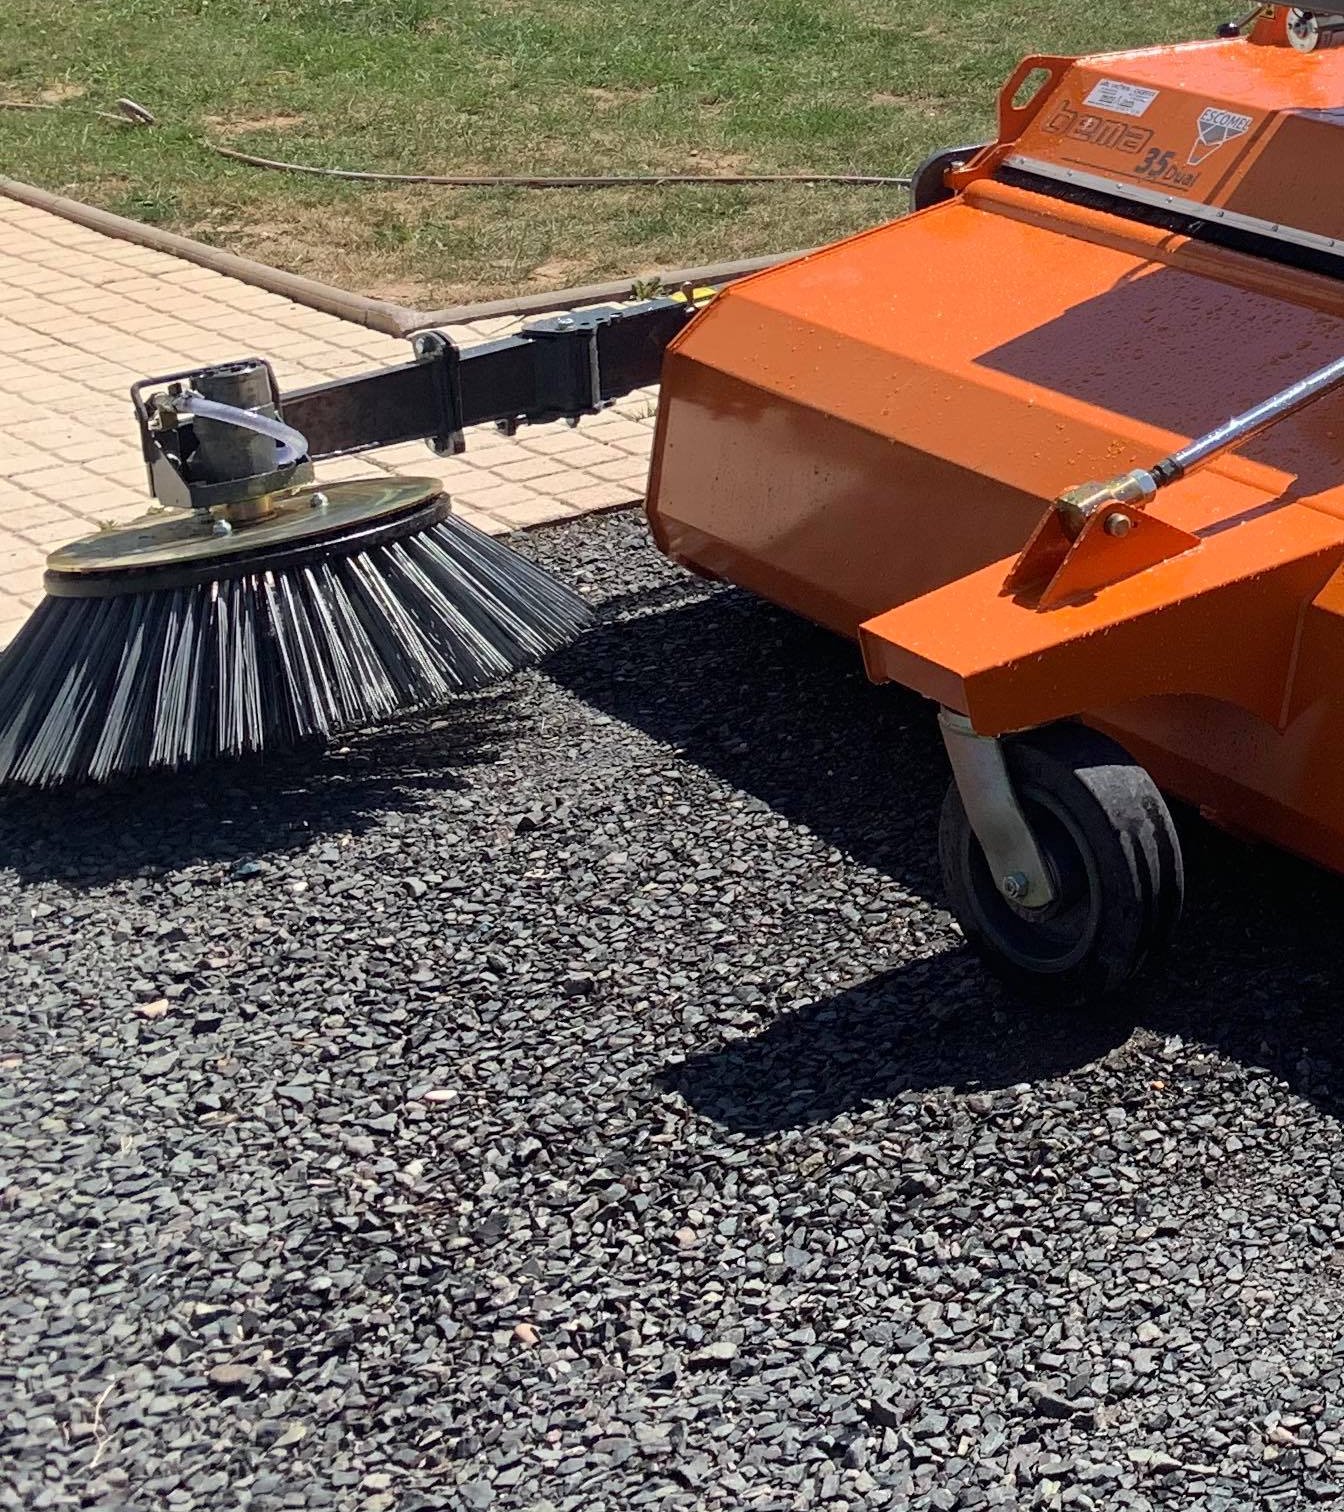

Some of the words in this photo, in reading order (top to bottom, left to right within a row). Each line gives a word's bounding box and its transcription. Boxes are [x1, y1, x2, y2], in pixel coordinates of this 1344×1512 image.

[1042, 99, 1154, 154] bema
[1201, 107, 1251, 130] ESCOMEL
[1134, 147, 1176, 177] 35
